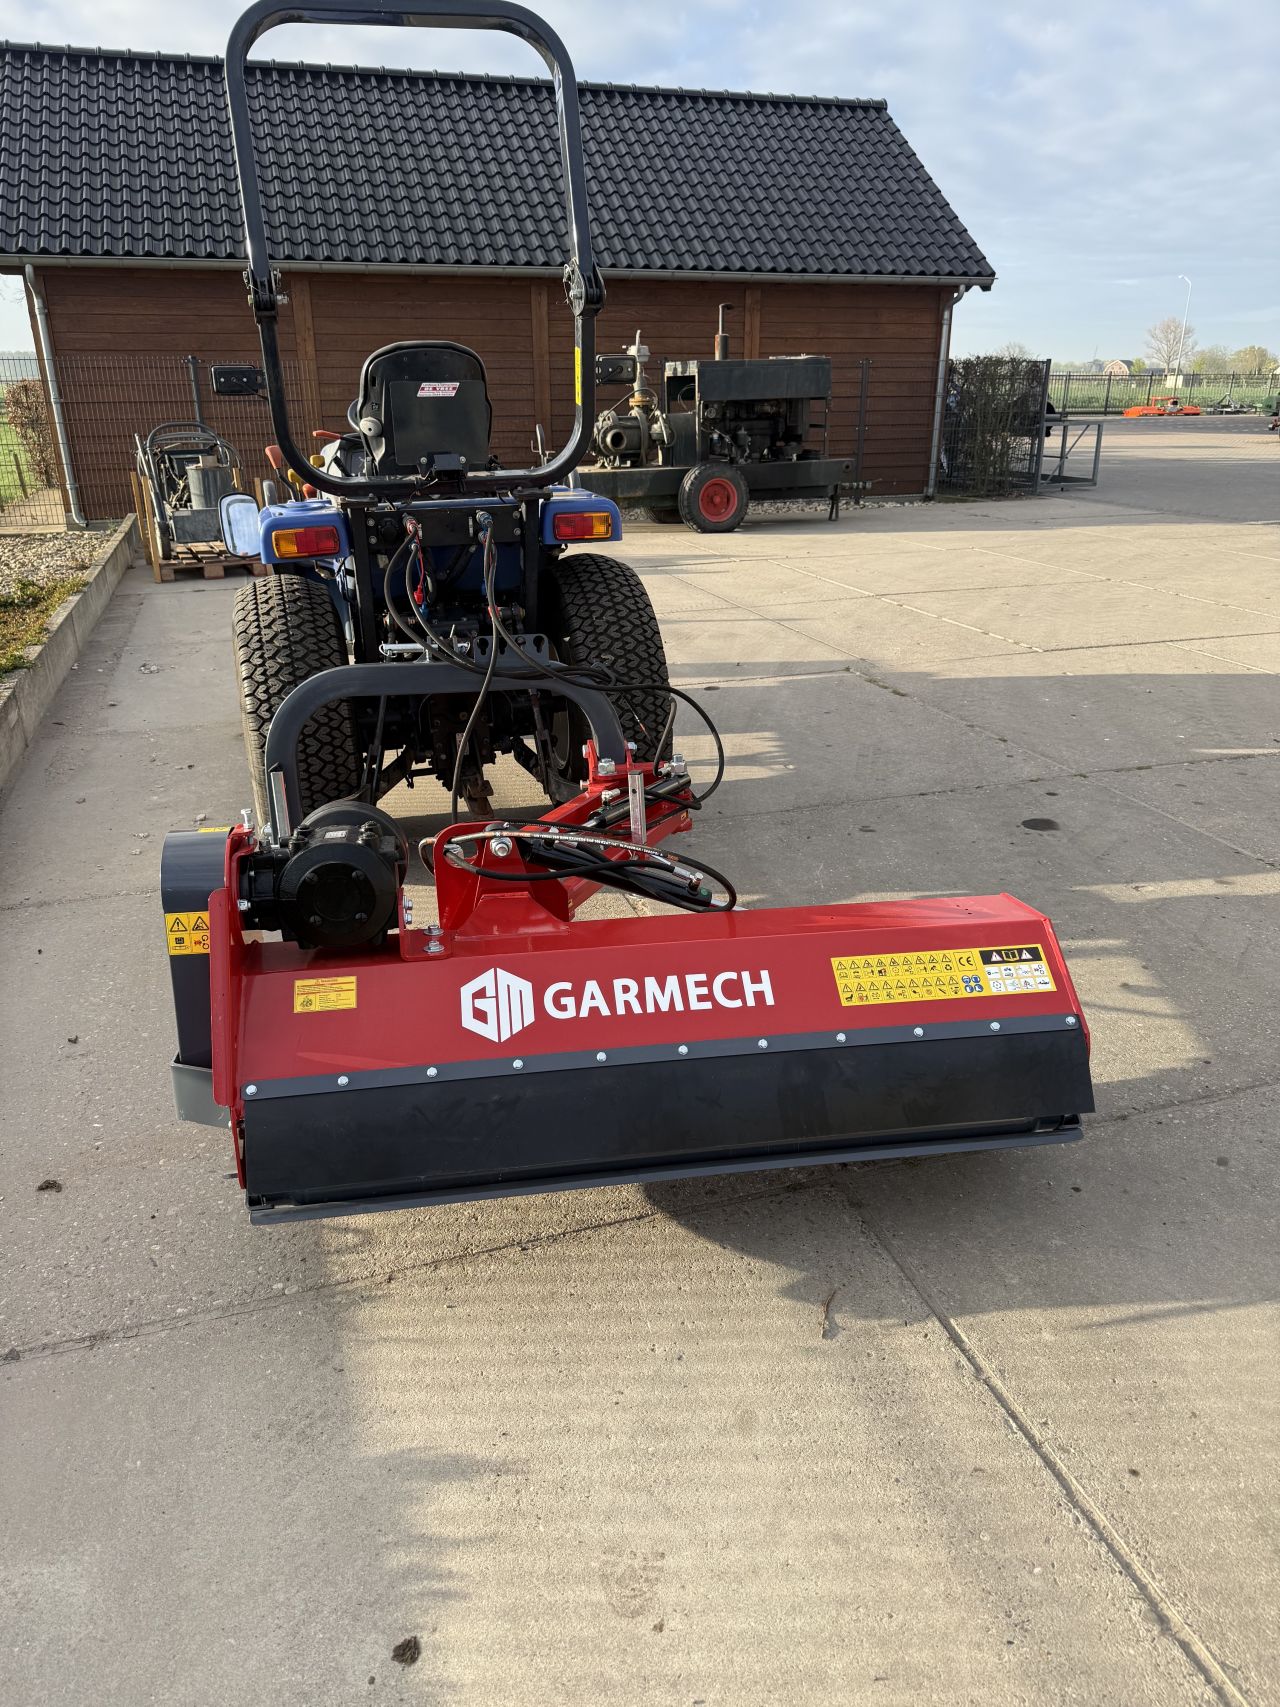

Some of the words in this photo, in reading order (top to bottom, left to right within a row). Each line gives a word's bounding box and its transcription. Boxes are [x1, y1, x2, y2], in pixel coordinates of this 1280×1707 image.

[958, 956, 973, 967] CE
[460, 967, 535, 1043] GM
[543, 969, 775, 1019] GARMECH
